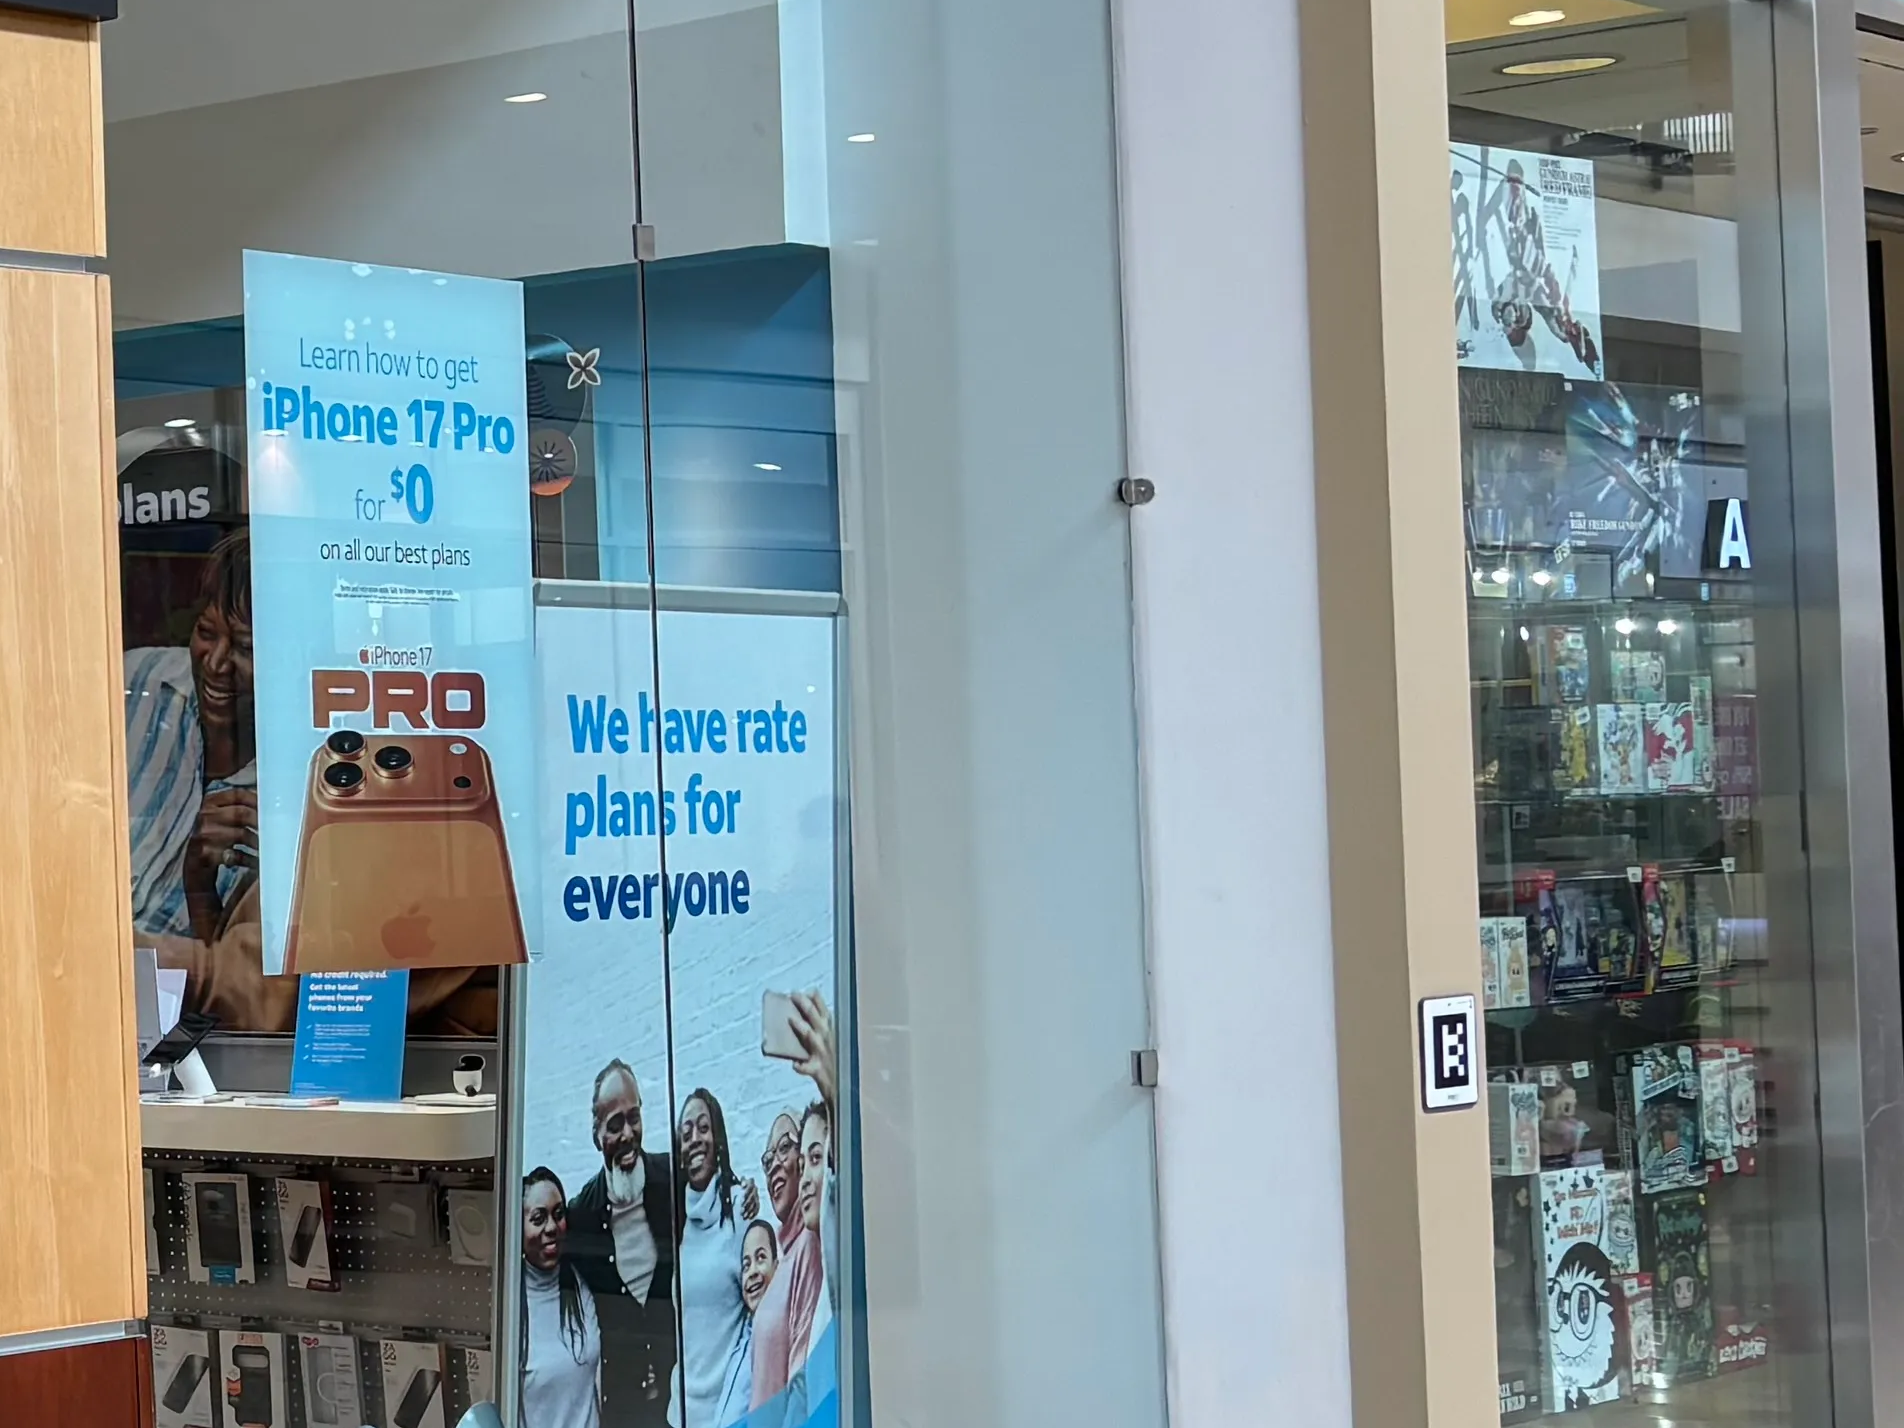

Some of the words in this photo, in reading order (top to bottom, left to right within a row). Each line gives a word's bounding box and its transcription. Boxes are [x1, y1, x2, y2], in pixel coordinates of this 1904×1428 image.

[299, 337, 360, 373] Learn
[366, 342, 411, 378] how
[417, 350, 439, 380] to
[444, 355, 479, 389] get
[262, 381, 398, 446] iPhone
[406, 399, 444, 449] 17
[453, 401, 515, 454] Pro
[118, 482, 210, 525] lans
[355, 489, 386, 521] for
[391, 463, 434, 524] $0
[320, 542, 340, 560] on
[344, 538, 360, 561] all
[364, 542, 391, 562] our
[394, 540, 427, 564] best
[432, 543, 471, 570] plans
[371, 646, 417, 666] iPhone
[419, 647, 433, 666] 17
[311, 670, 485, 729] PRO
[566, 694, 629, 754] We
[638, 691, 727, 754] have
[736, 700, 807, 754] rate
[565, 774, 676, 855] plans
[684, 773, 741, 834] for
[563, 870, 750, 935] everyone
